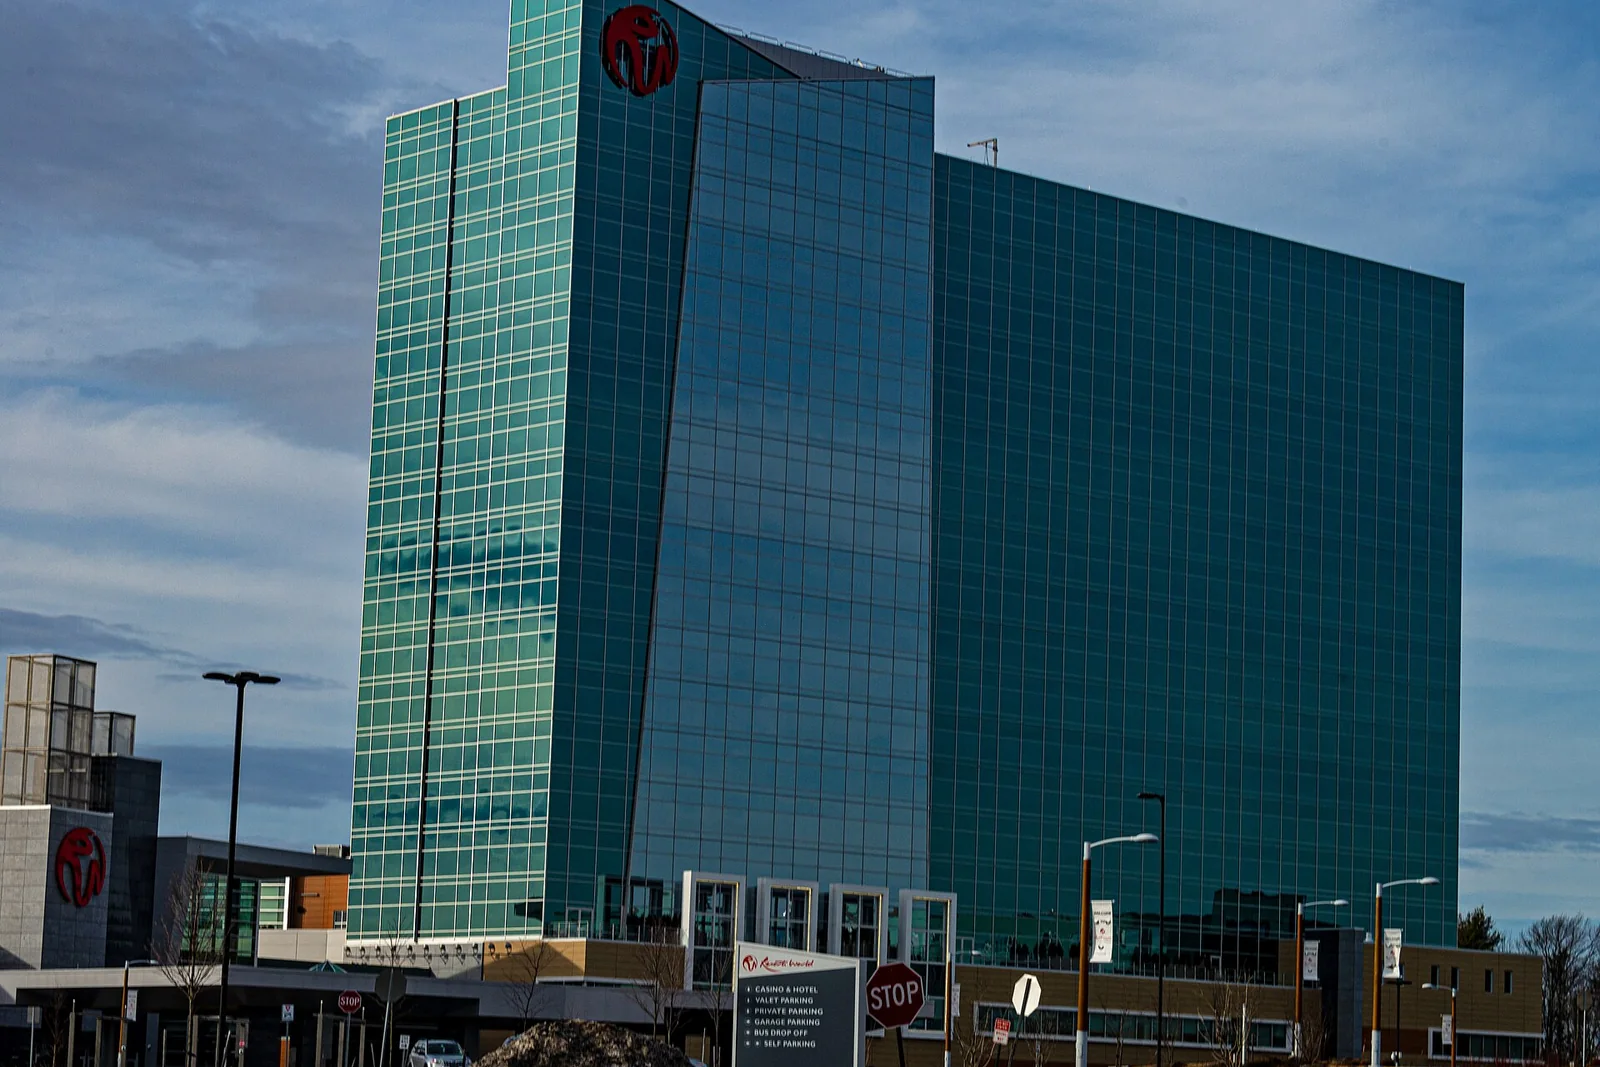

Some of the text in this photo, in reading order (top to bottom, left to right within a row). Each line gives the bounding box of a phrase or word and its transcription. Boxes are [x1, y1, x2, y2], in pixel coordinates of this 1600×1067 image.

[755, 985, 784, 994] CASINO
[793, 985, 818, 994] HOTEL
[870, 981, 919, 1010] STOP
[340, 996, 360, 1007] STOP
[780, 997, 814, 1005] PARKING
[754, 1007, 824, 1016] PRIVATE PARKING
[754, 1018, 820, 1027] GARAGE PARKING
[754, 1029, 808, 1037] BUS DROP OFF
[764, 1040, 816, 1049] SELF PARKING
